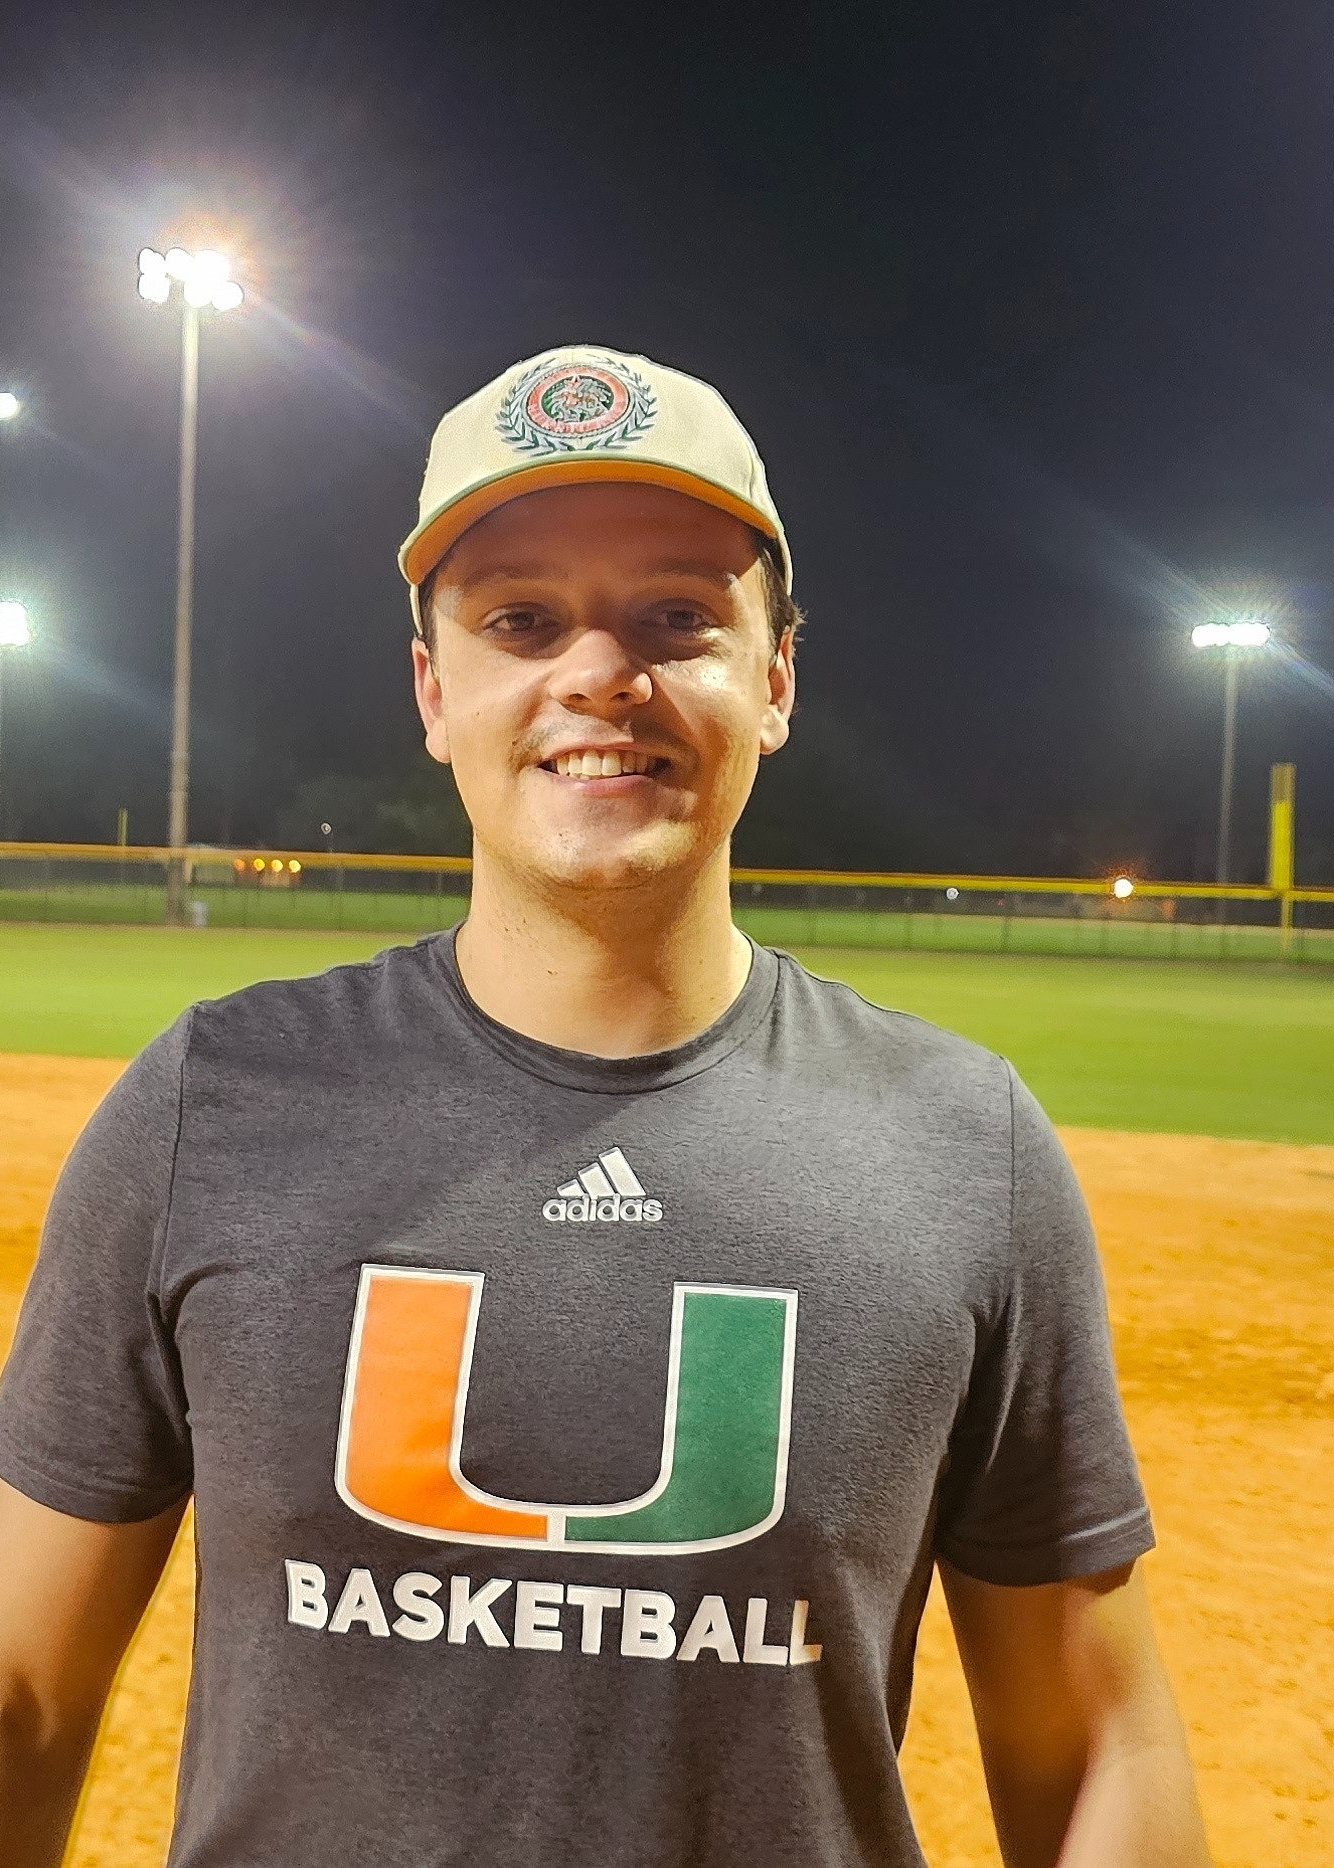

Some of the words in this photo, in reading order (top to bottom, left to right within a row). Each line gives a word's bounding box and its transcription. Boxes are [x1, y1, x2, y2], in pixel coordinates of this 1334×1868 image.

[542, 1193, 663, 1221] adidas
[335, 1263, 799, 1555] U
[285, 1559, 823, 1666] BASKETBALL
